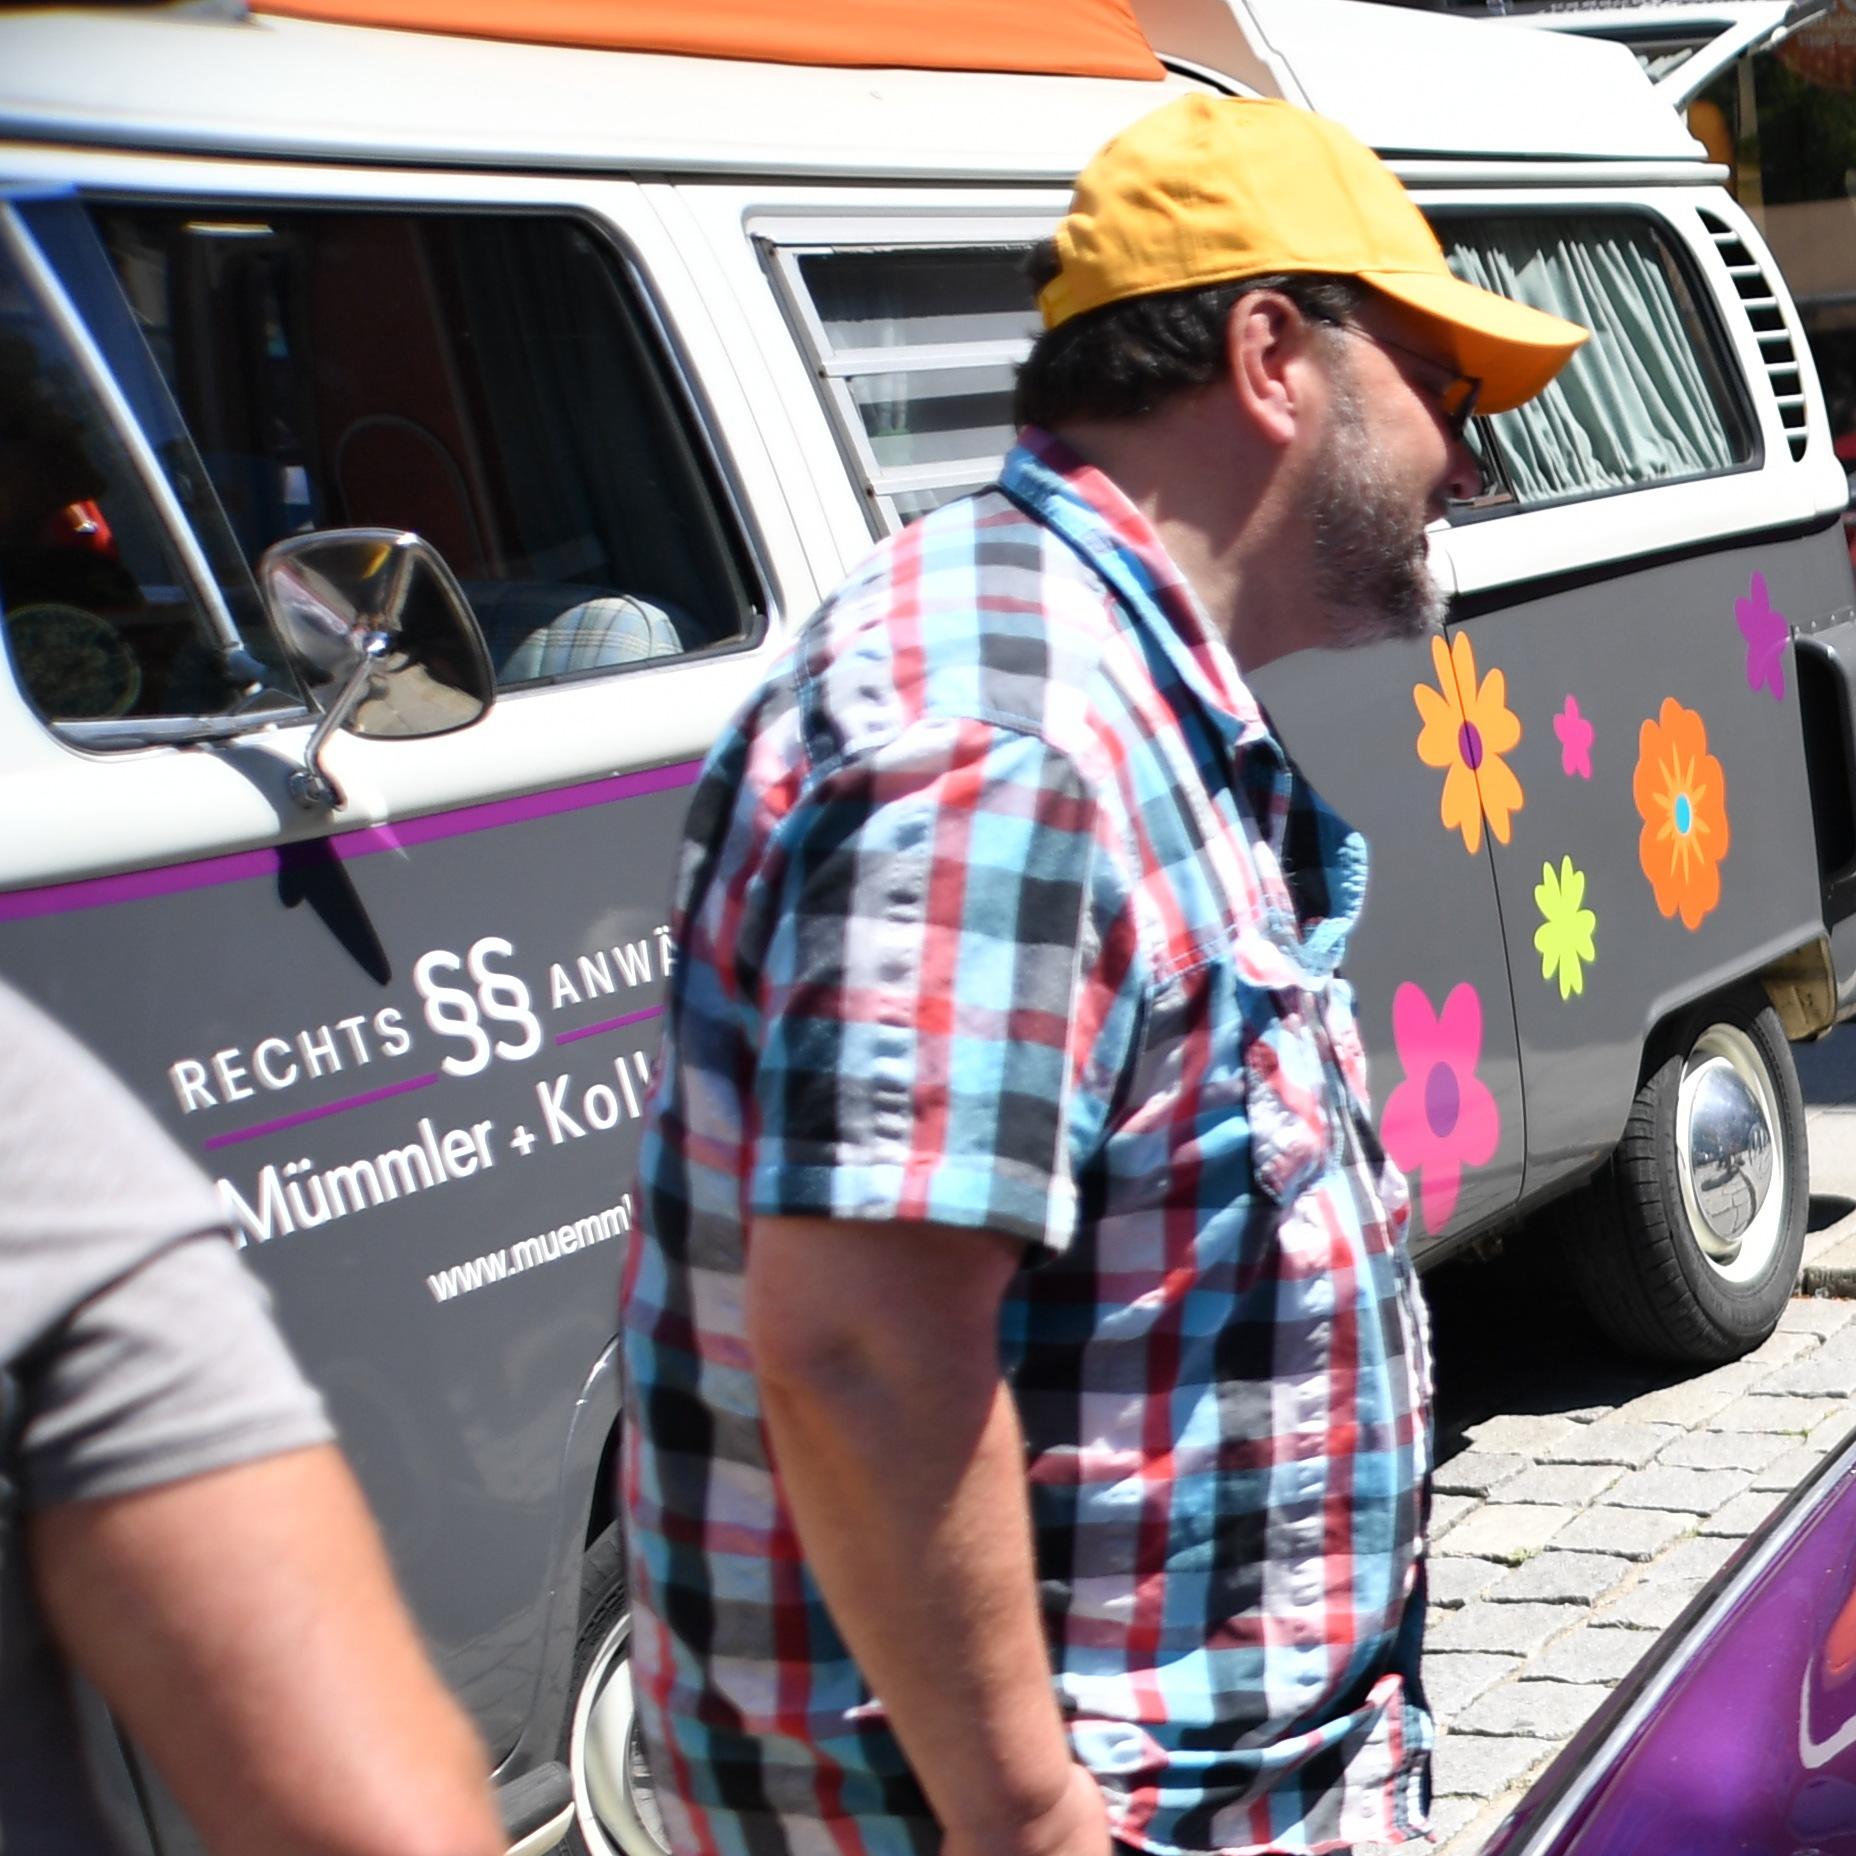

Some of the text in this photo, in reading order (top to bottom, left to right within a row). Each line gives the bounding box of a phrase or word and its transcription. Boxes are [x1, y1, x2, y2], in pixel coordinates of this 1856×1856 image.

[167, 1007, 413, 1115] RECHTS
[215, 1117, 495, 1250] Mümmler
[510, 1124, 538, 1156] +
